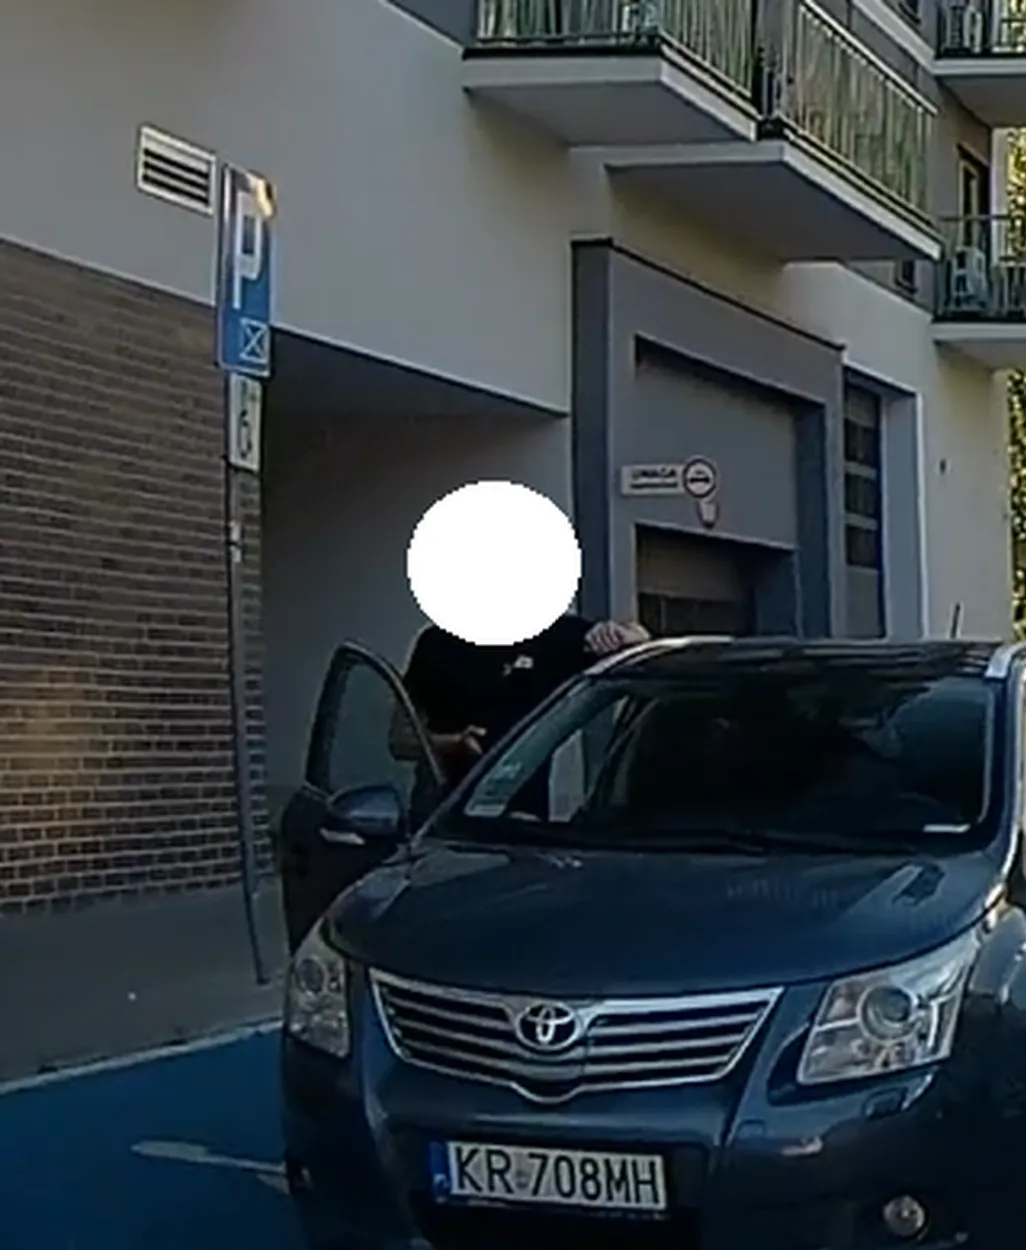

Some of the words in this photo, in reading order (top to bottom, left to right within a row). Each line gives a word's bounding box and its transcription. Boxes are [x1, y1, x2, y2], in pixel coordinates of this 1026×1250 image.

[233, 190, 263, 310] P
[455, 1146, 514, 1195] KR
[528, 1152, 661, 1204] 708MH
